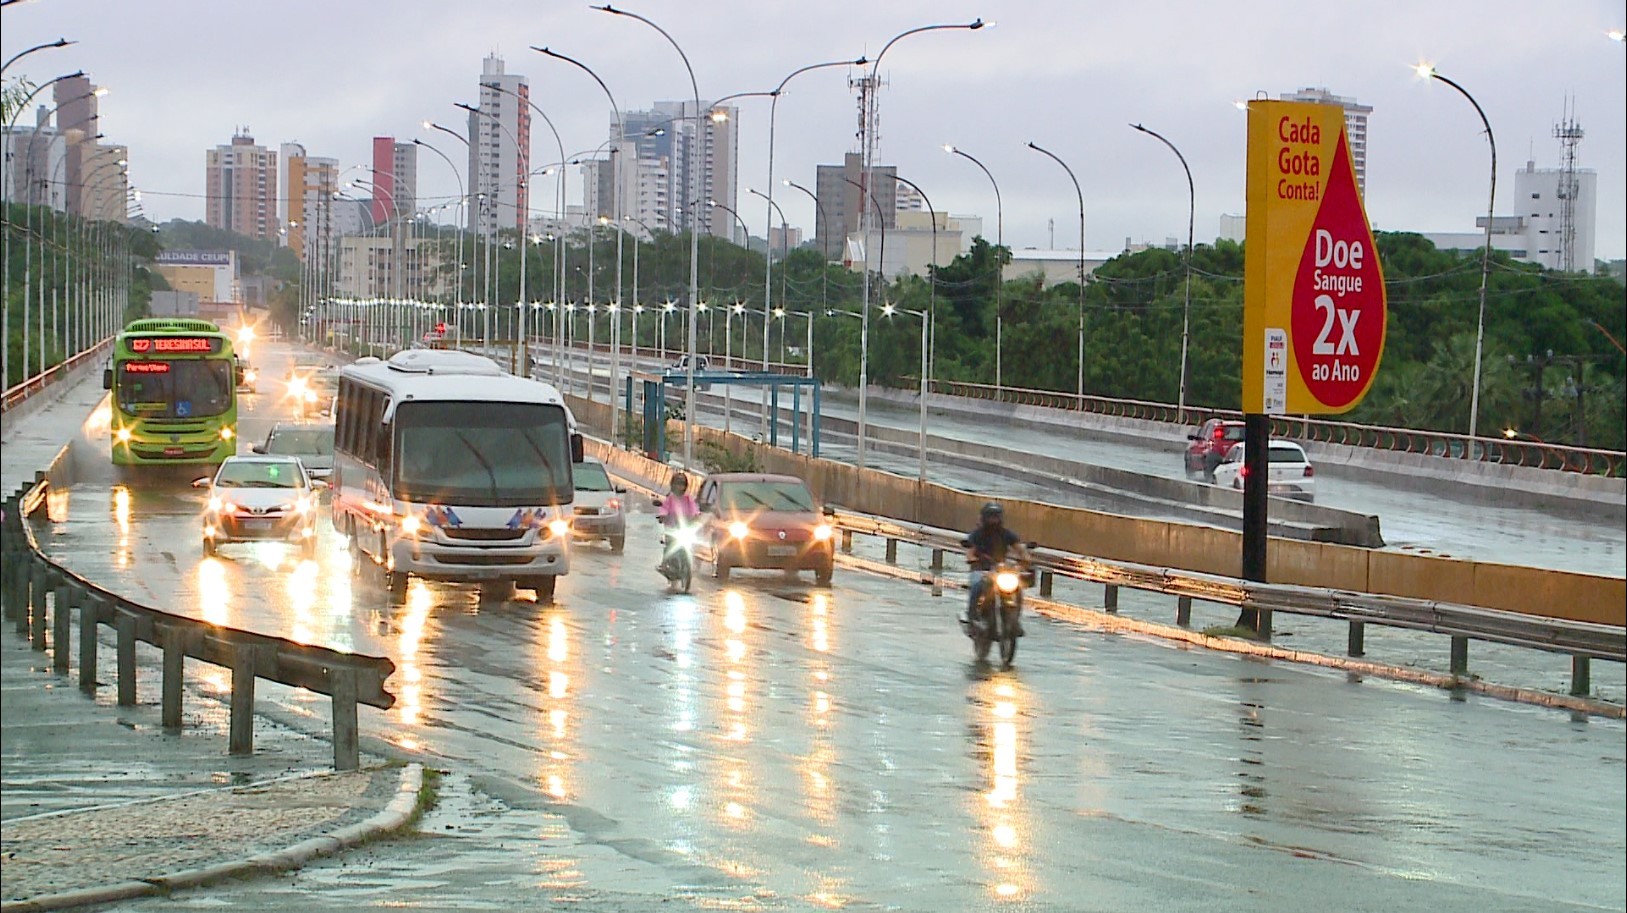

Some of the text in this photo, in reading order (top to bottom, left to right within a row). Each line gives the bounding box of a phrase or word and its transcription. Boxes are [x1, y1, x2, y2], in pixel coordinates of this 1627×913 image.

[1279, 116, 1320, 144] Cada
[1279, 147, 1320, 176] Gota
[1278, 178, 1320, 201] Conta!
[1315, 229, 1363, 269] Doe
[1313, 269, 1362, 297] Sangue
[1312, 294, 1361, 356] 2x
[1312, 359, 1360, 382] ao Ano
